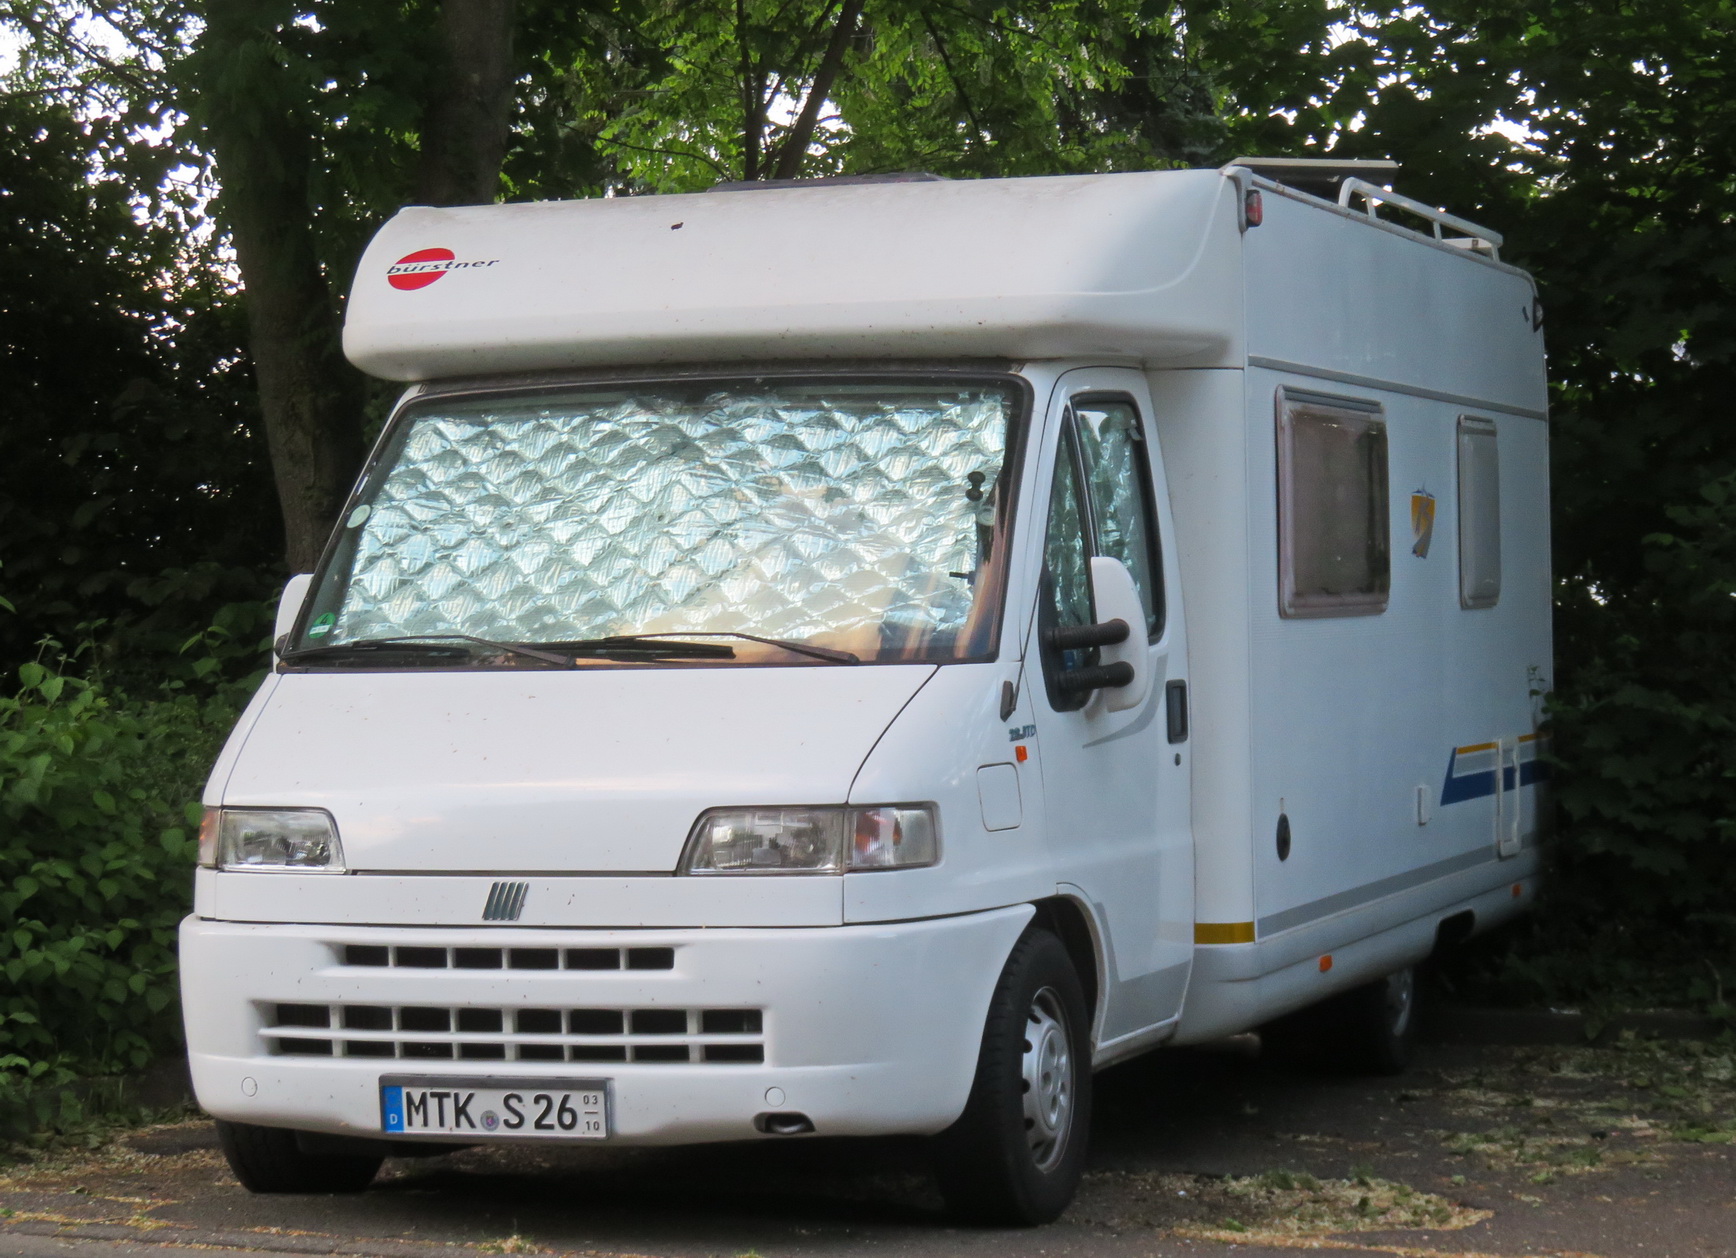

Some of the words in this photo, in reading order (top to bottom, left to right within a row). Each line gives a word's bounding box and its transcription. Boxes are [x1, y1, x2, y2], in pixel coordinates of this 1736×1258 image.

[386, 259, 500, 275] bürstner
[583, 1094, 598, 1105] 03
[405, 1091, 477, 1128] MTK
[389, 1113, 398, 1125] D
[585, 1121, 600, 1131] 10
